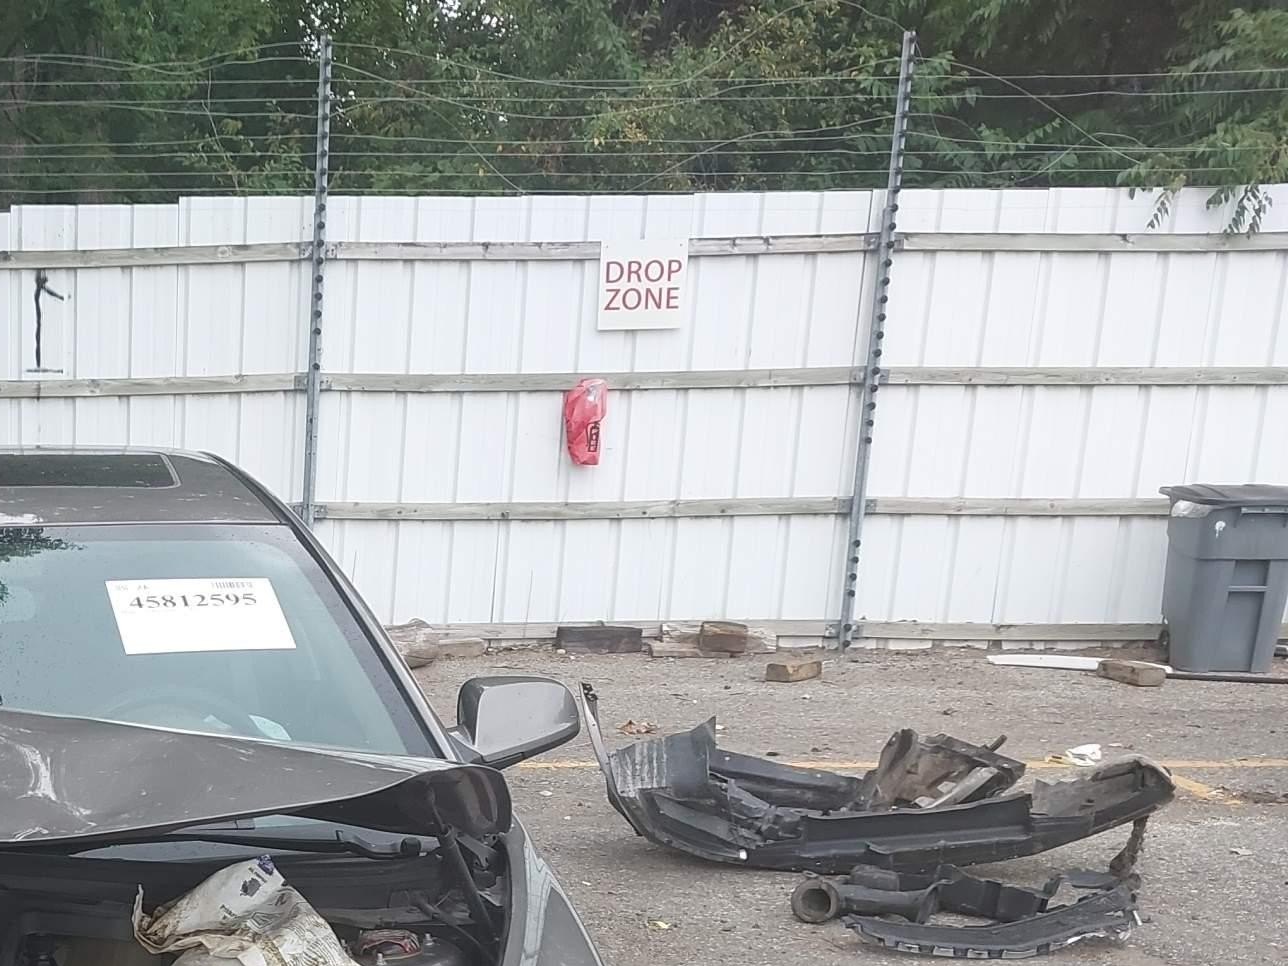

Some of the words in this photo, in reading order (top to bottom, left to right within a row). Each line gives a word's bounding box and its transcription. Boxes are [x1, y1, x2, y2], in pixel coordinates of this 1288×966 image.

[605, 259, 683, 283] DROP
[603, 286, 681, 310] ZONE
[128, 592, 258, 610] 45812595
